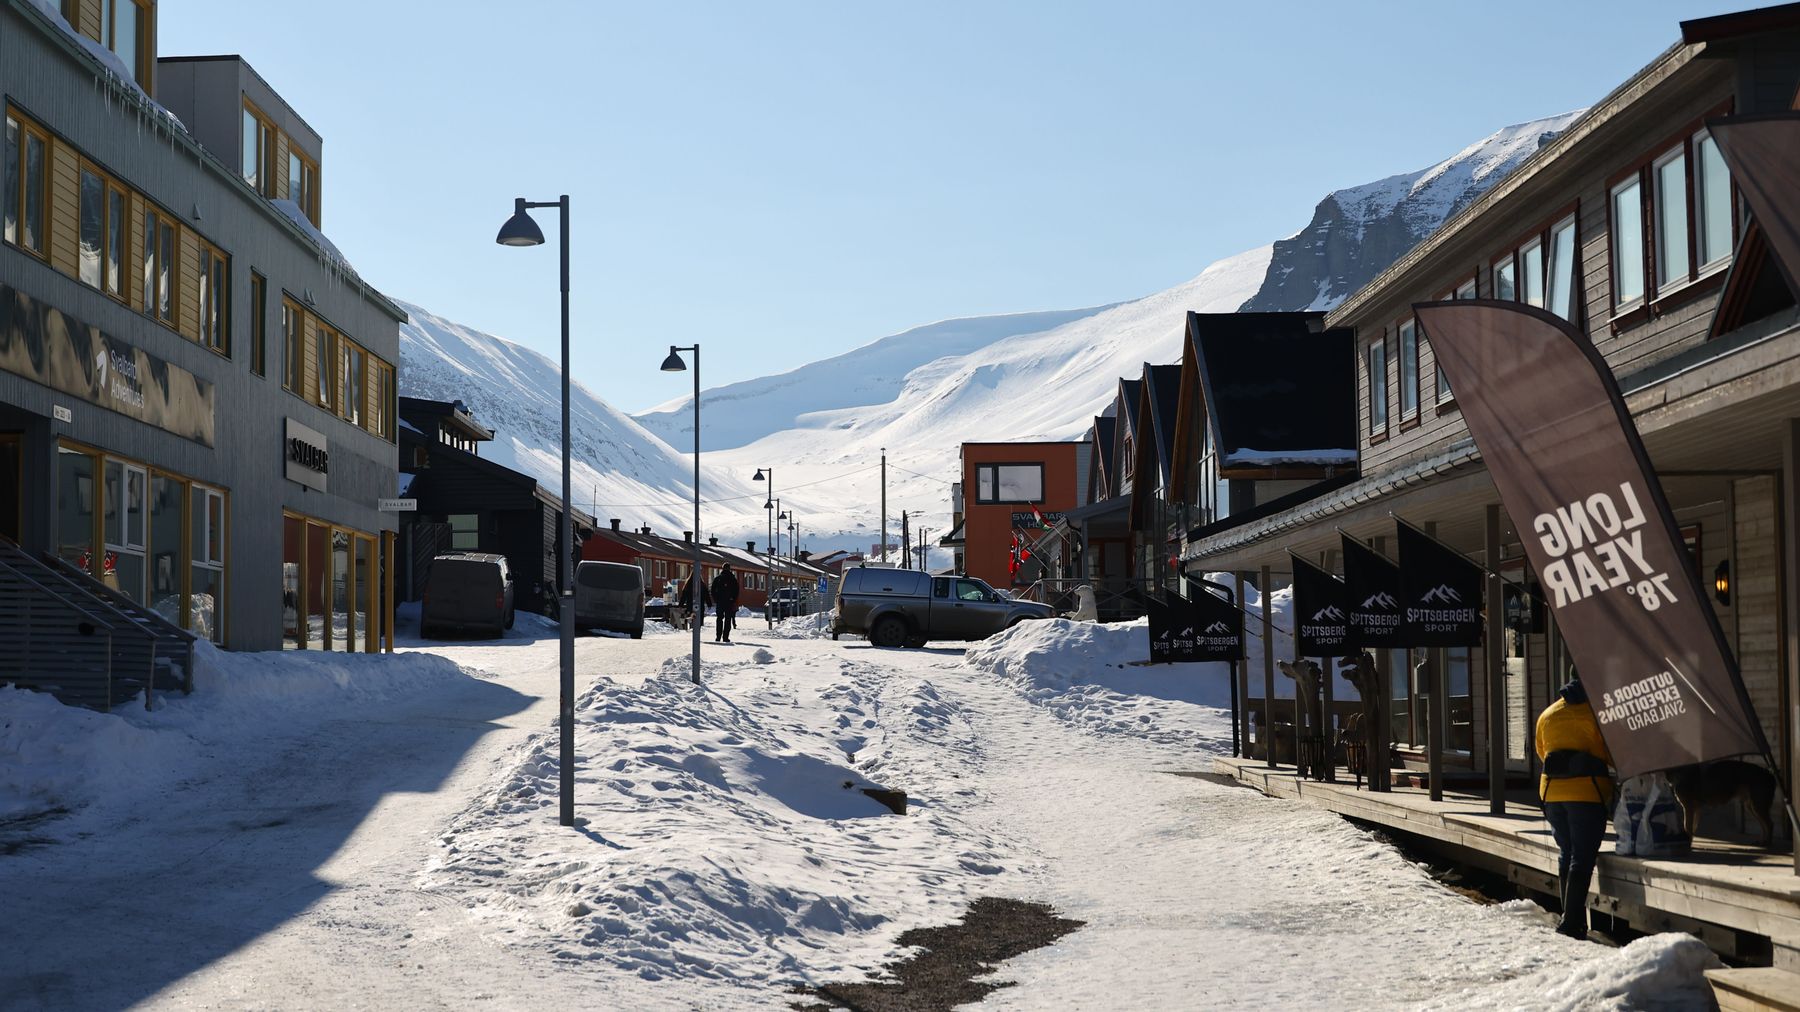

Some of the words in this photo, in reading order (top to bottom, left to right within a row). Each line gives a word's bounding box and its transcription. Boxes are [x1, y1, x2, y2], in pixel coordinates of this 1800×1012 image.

[292, 437, 328, 474] SVALBAR
[1407, 607, 1475, 623] SPITSBERGEN
[1302, 624, 1346, 637] SPITSBERG
[1363, 626, 1394, 635] SPORT
[1424, 623, 1458, 632] SPORT
[1196, 635, 1239, 646] SPITSBERGEN
[1316, 637, 1343, 645] SPORT
